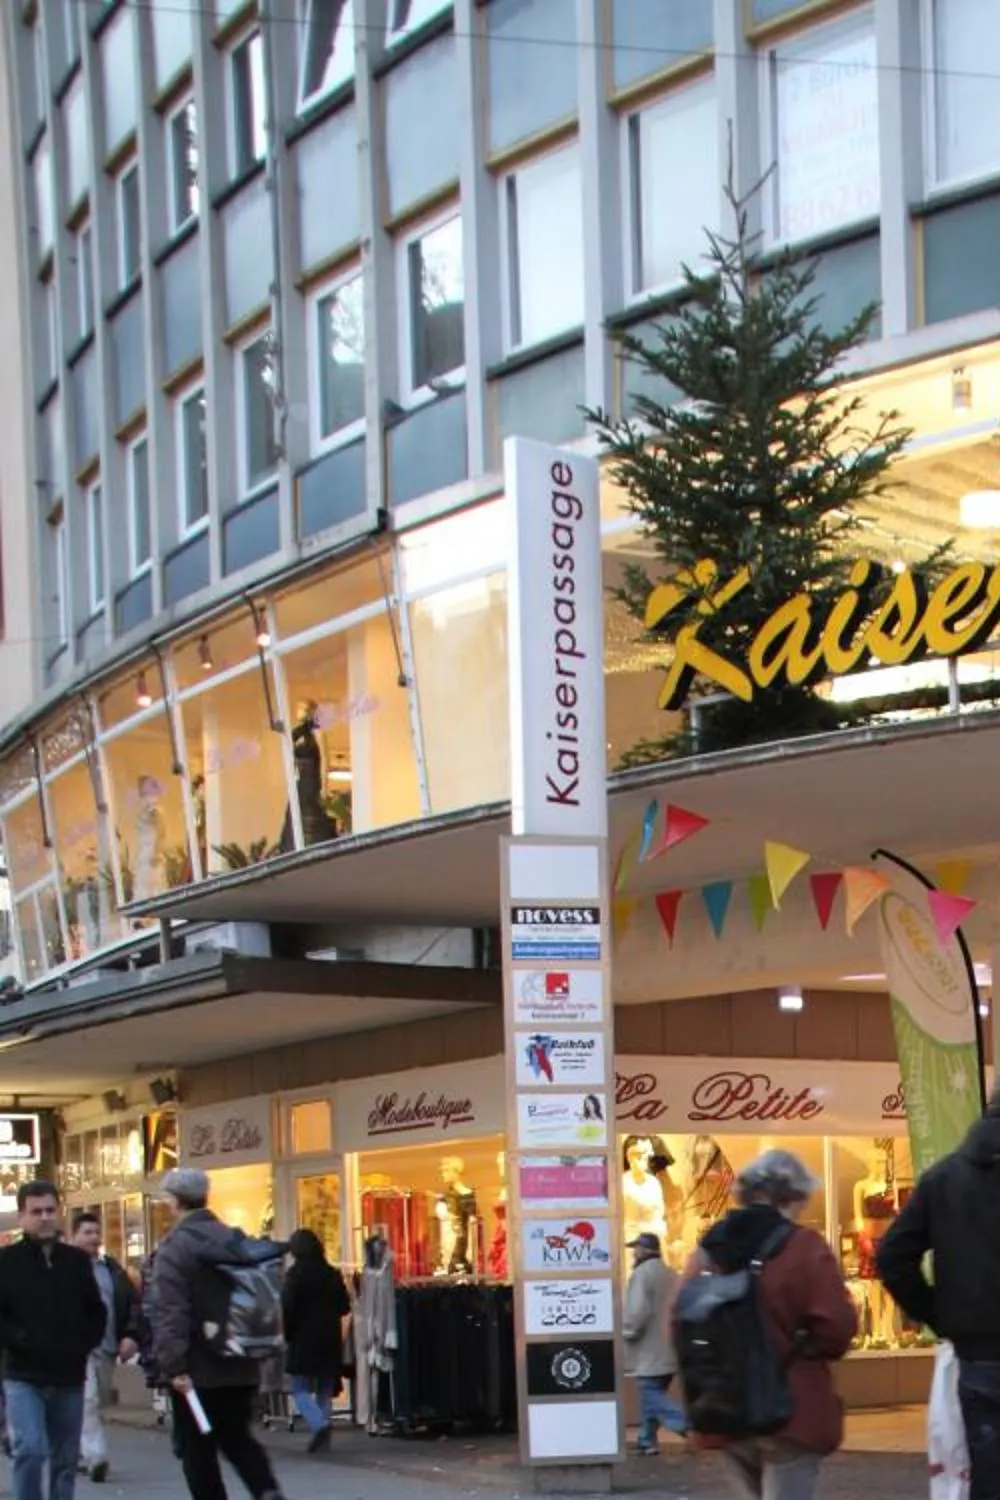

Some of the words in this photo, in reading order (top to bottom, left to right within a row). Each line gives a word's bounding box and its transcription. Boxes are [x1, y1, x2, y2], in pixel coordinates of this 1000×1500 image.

[546, 461, 584, 806] Kaiserpassage
[616, 1072, 668, 1121] La
[687, 1071, 824, 1121] Petite
